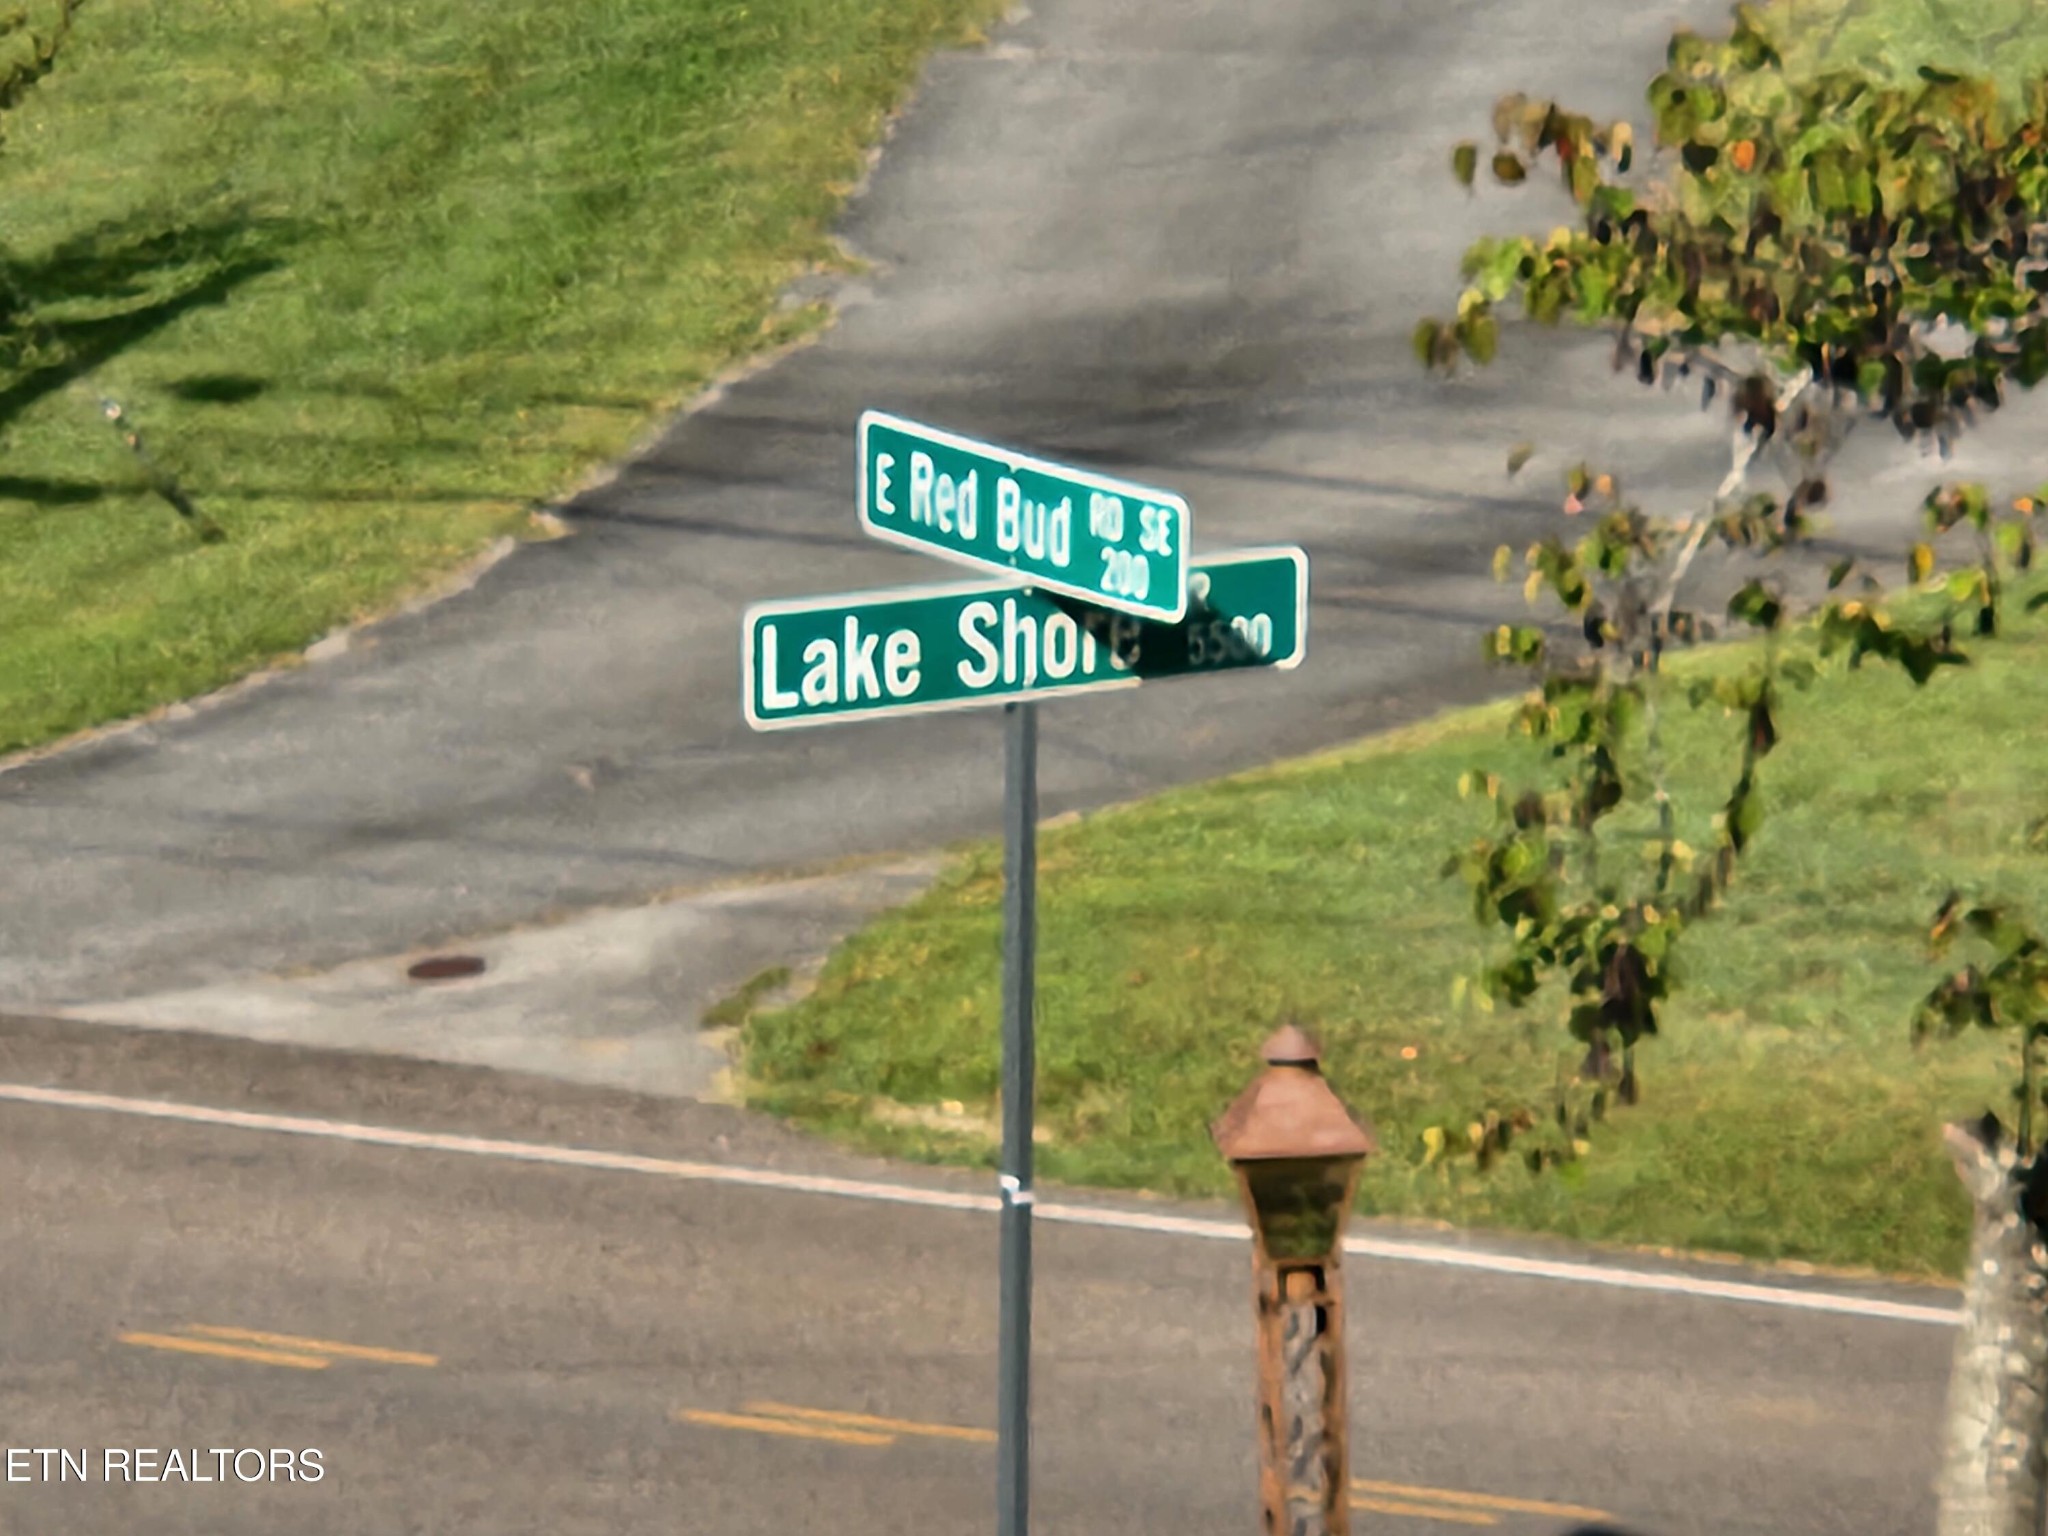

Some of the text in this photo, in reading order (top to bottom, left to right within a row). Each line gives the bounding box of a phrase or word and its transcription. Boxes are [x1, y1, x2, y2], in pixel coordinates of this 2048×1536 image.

[876, 453, 895, 514] E
[910, 451, 978, 540] Red
[997, 476, 1072, 567] Bud
[1138, 503, 1172, 556] SE
[1100, 546, 1150, 600] 200
[761, 597, 1141, 710] Lake Shore
